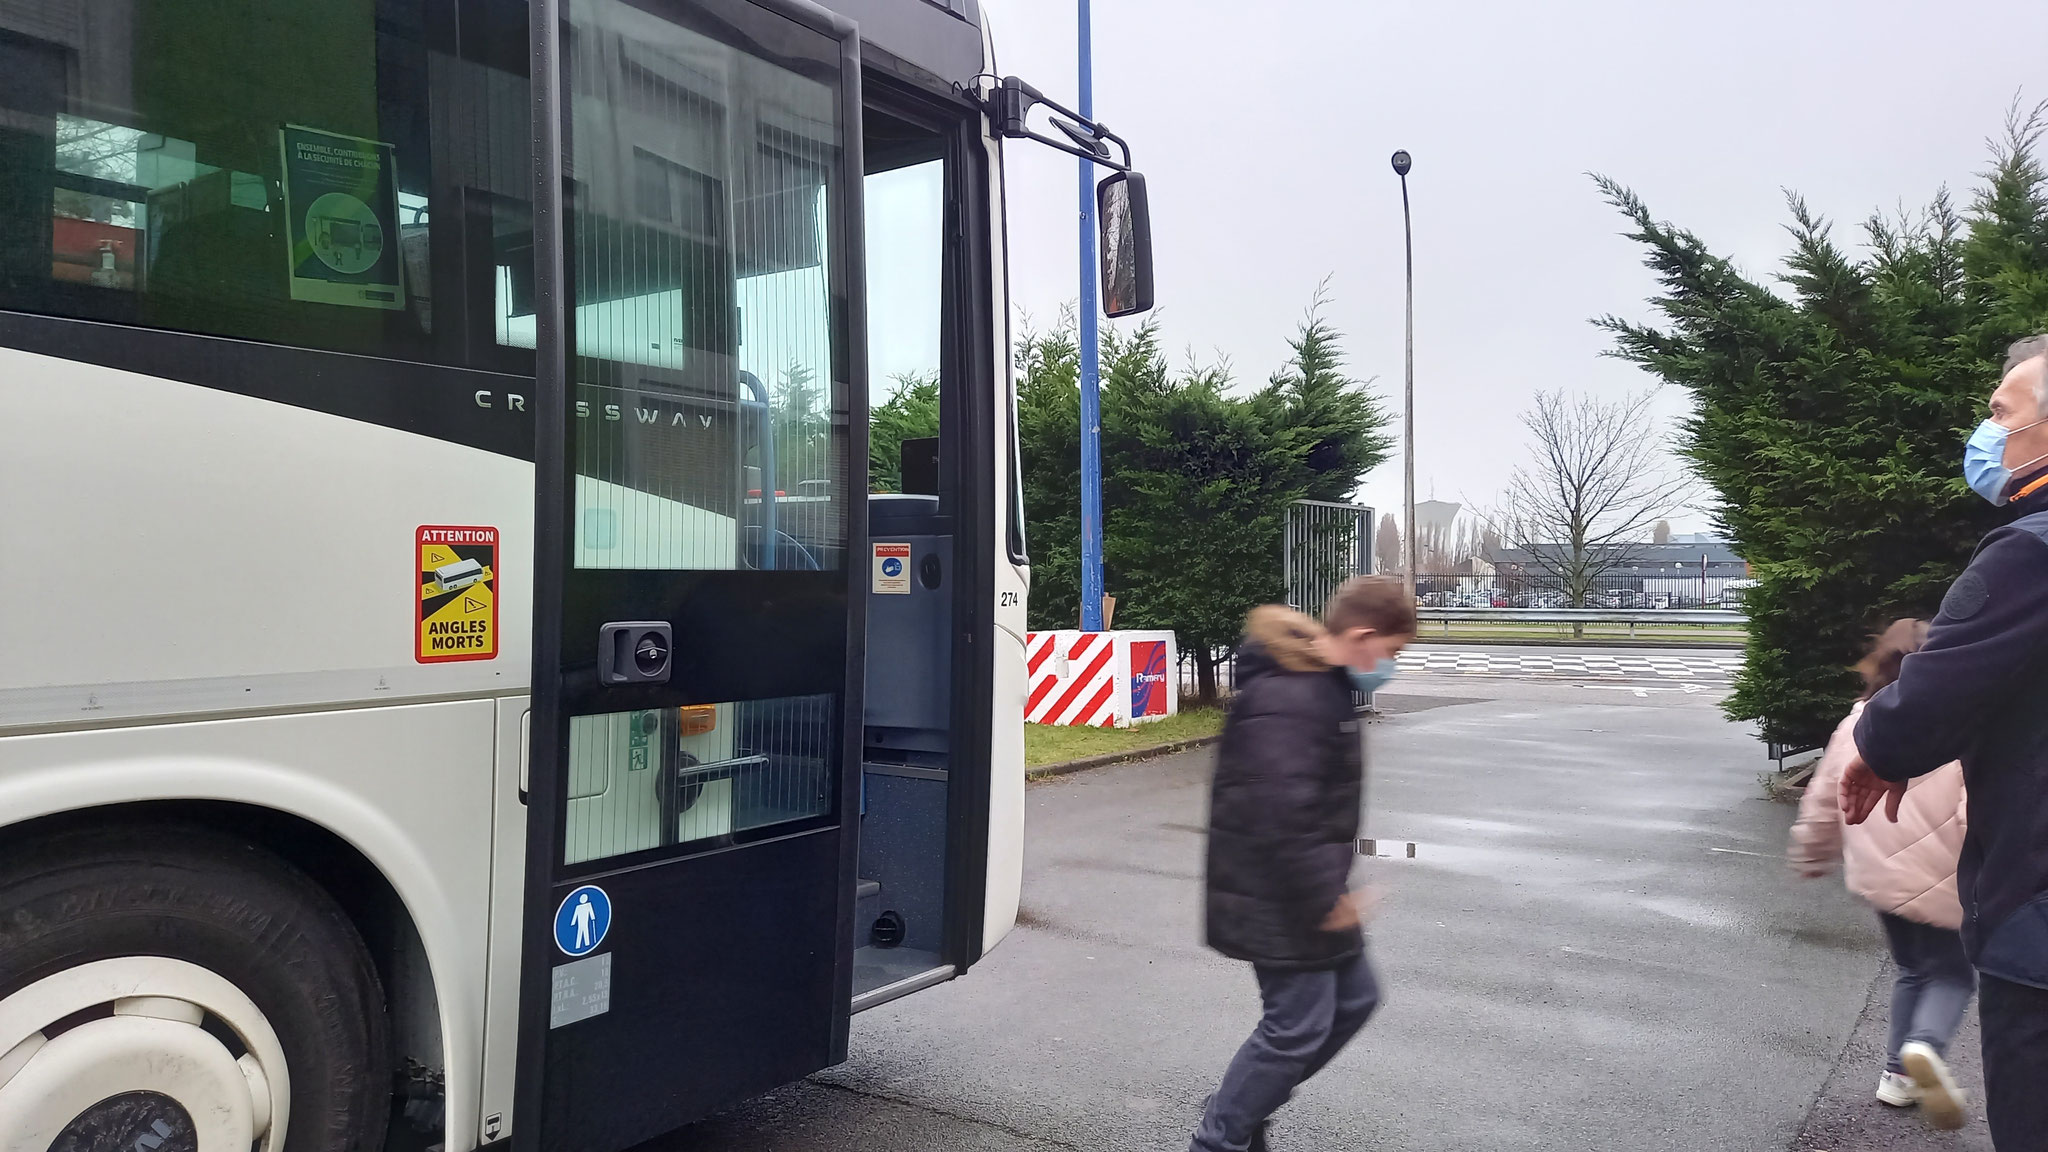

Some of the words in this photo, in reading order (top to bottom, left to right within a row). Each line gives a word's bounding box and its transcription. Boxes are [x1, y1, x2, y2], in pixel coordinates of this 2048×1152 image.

[474, 389, 712, 431] CRSSWAY
[421, 530, 494, 542] ATTENTION
[1001, 592, 1018, 607] 274
[428, 620, 487, 635] ANGLES
[431, 635, 484, 650] MORTS
